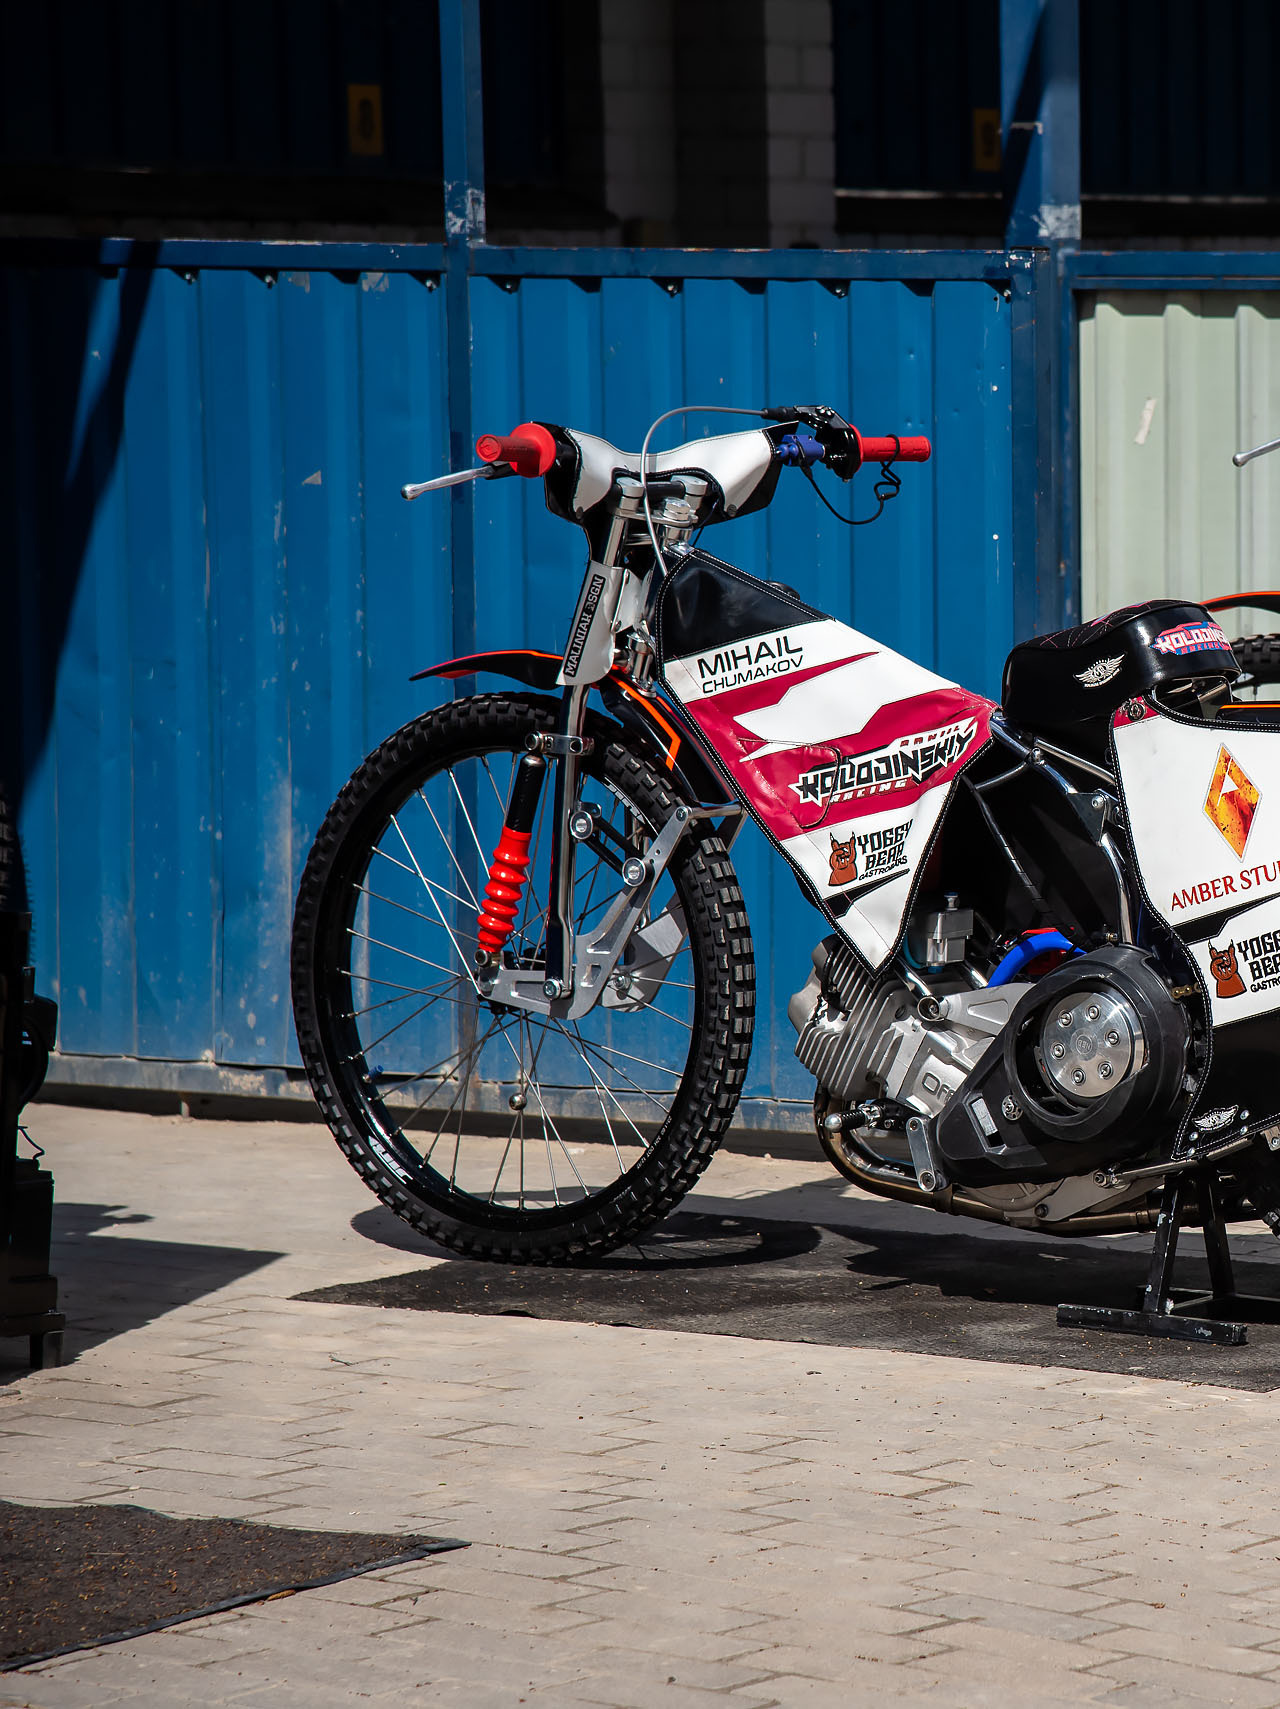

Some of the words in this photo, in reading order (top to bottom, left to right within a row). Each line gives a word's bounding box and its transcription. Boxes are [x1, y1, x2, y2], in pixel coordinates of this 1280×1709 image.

[697, 636, 803, 679] MIHAIL
[702, 655, 803, 694] CHUMAKOV
[857, 818, 913, 855] YOGGY
[865, 841, 905, 872] BEAR
[1171, 875, 1238, 912] AMBER
